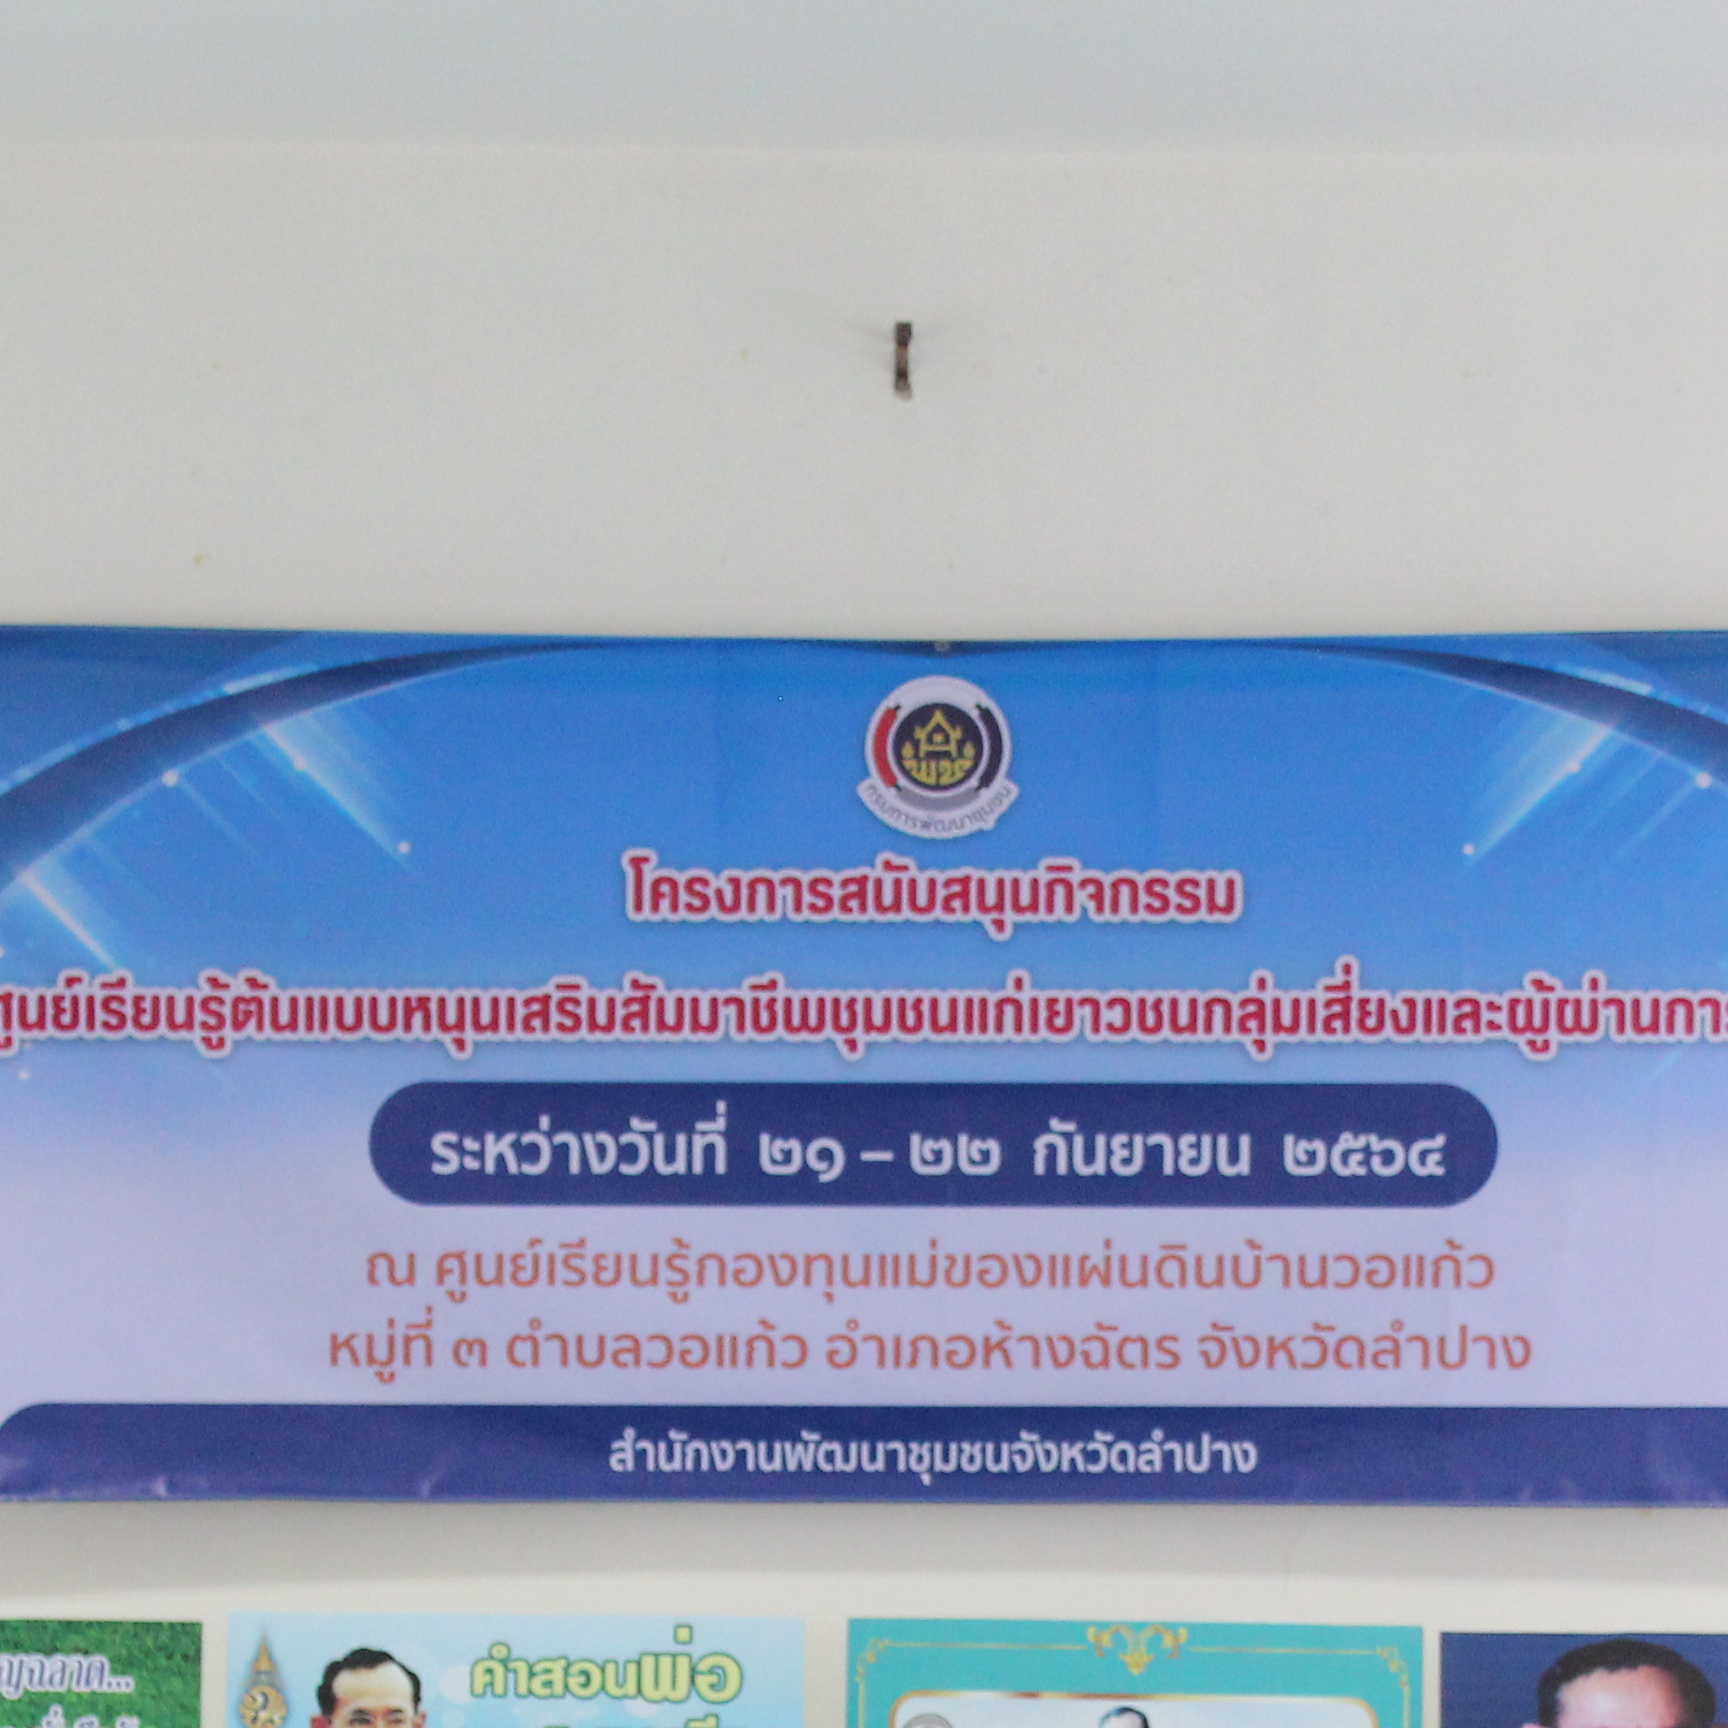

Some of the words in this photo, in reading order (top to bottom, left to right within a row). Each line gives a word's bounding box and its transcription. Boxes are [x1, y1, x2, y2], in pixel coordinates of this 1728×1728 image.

[624, 855, 1239, 932] โครงการสนับสนุนกิจกรรม
[431, 1103, 728, 1176] ระหว่างวันที่
[759, 1134, 846, 1182] ๒๑
[908, 1132, 1000, 1177] ๒๒
[1033, 1117, 1252, 1177] กันยายน
[1284, 1130, 1446, 1178] ๒๕๖๔
[367, 1252, 417, 1290] ณ
[436, 1237, 1495, 1304] ศูนย์เรียนรู้กองทุนแม่ของแผ่นดินบ้านวอแก้ว
[331, 1307, 433, 1385] หมู่ที่
[454, 1334, 487, 1368] ๓
[507, 1316, 809, 1370] ตำบลวอแก้ว
[827, 1318, 1181, 1372] อำเภอห้างฉัตร
[1198, 1318, 1533, 1373] จังหวัดลำปาง
[610, 1424, 1258, 1486] สำนักงานพัฒนาชุมชนจังหวัดลำปาง
[472, 1625, 742, 1703] คำสอนพ่อ
